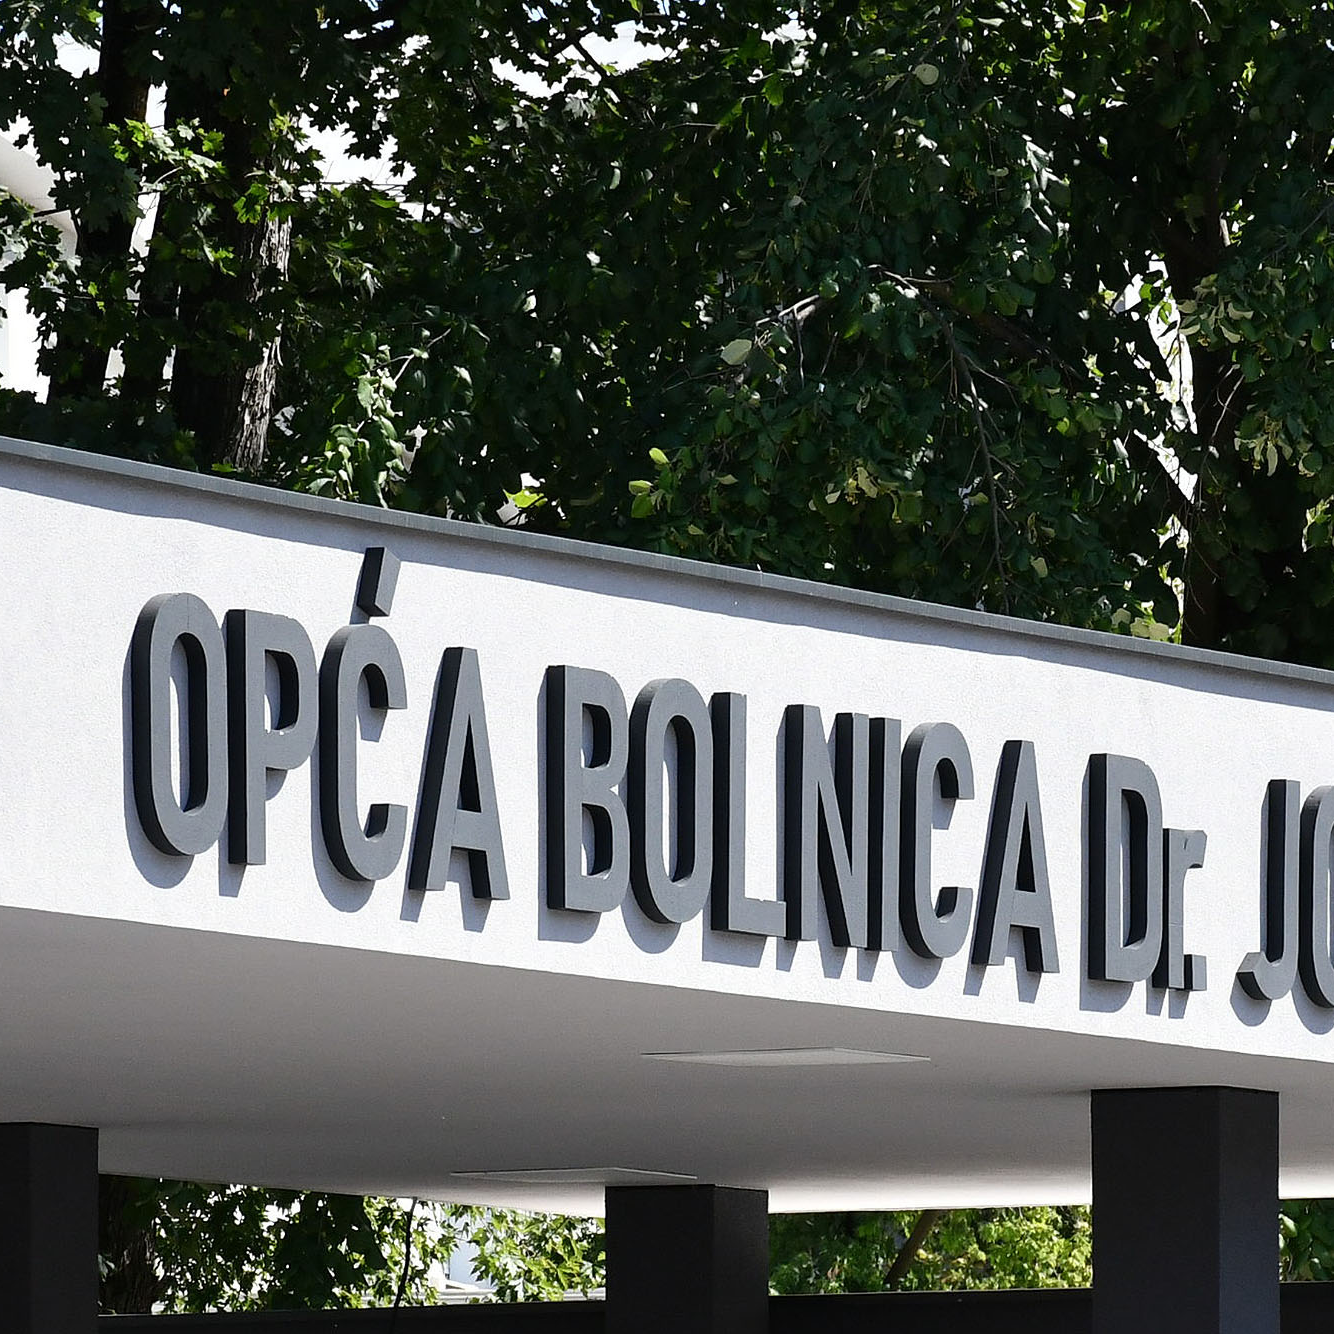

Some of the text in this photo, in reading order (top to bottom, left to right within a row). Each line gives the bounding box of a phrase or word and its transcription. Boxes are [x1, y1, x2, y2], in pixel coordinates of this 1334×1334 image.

[130, 547, 509, 900] OPĆA
[545, 664, 1058, 974] BOLNICA
[1087, 753, 1207, 992] Dr.
